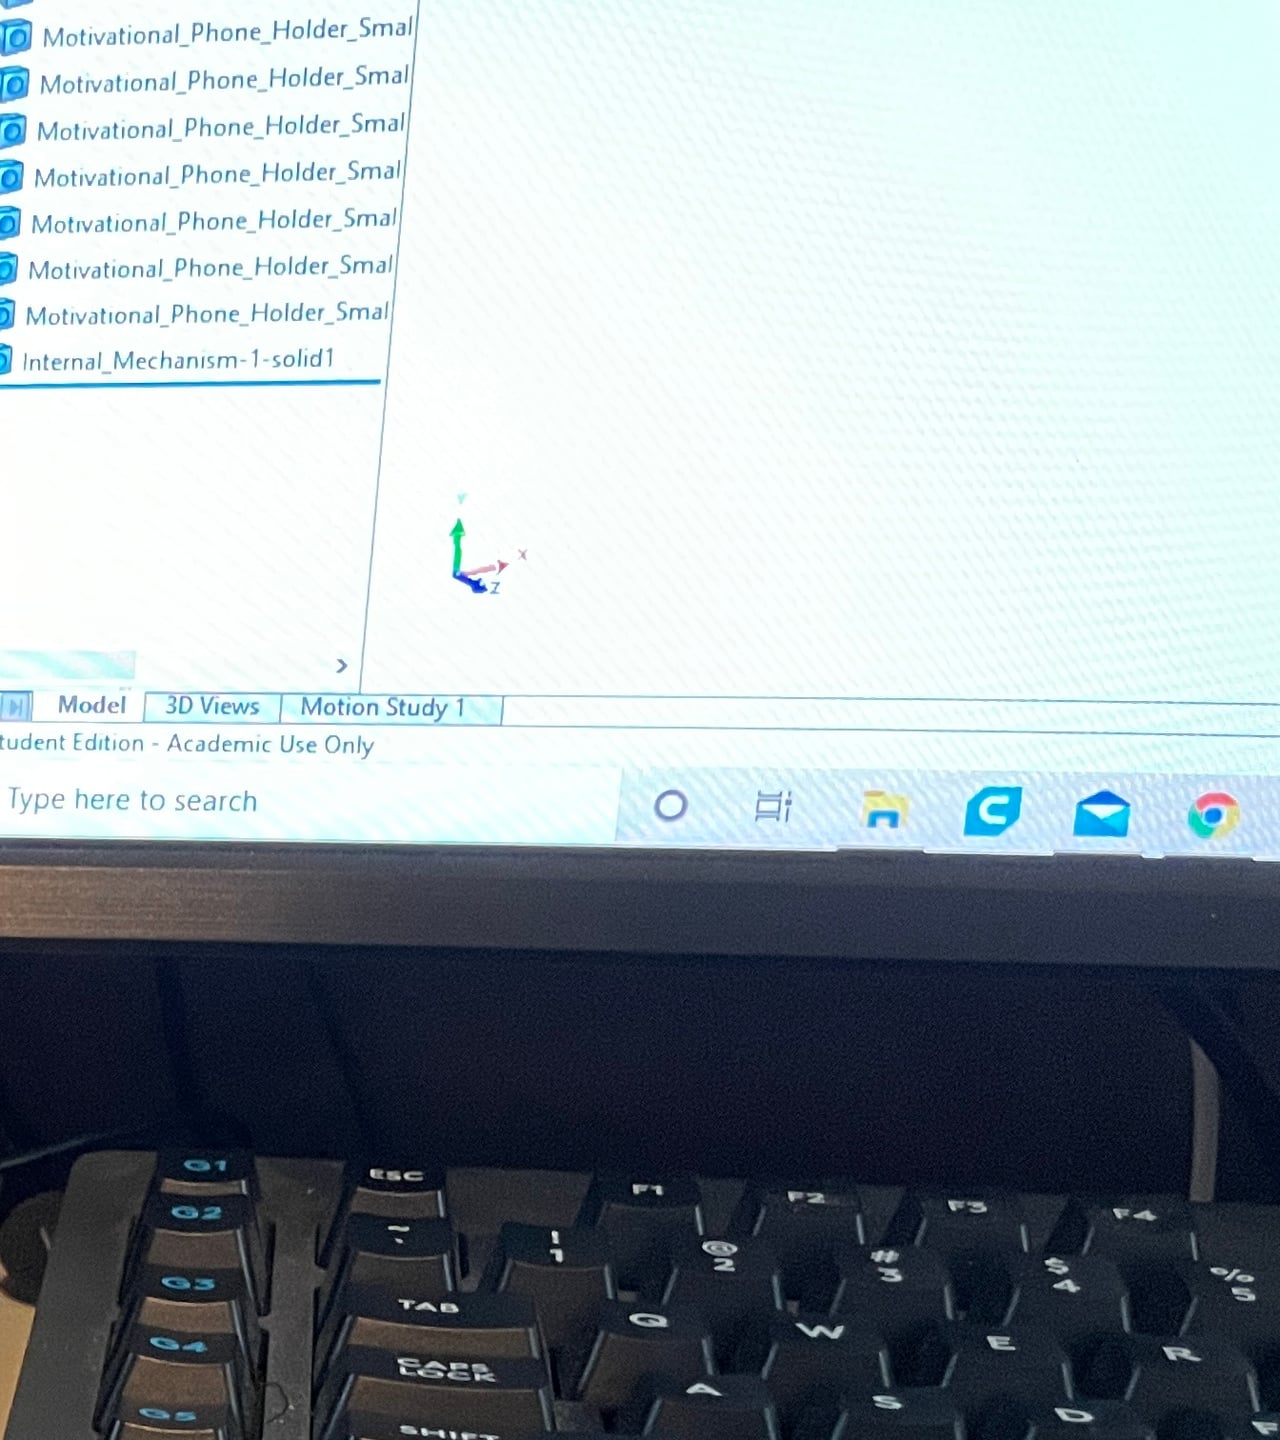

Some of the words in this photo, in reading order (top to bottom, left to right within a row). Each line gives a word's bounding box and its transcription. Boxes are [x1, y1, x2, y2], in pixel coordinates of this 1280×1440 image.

[57, 694, 127, 716] Model
[165, 696, 194, 716] 3D
[199, 696, 260, 717] Views
[301, 696, 378, 718] Motion
[385, 696, 447, 722] Study
[455, 697, 465, 717] 1
[73, 732, 144, 753] Edition
[167, 733, 271, 755] Academic
[280, 735, 317, 756] Use
[324, 735, 375, 760] Only
[7, 786, 65, 813] Type
[75, 788, 130, 811] here
[140, 790, 166, 813] to
[174, 789, 258, 814] search
[183, 1159, 228, 1172] G1
[369, 1168, 424, 1182] ESC
[632, 1184, 664, 1196] F1
[787, 1190, 825, 1204] F2
[170, 1205, 223, 1221] G2
[947, 1200, 988, 1213] F3
[1112, 1207, 1158, 1221] F4
[702, 1240, 738, 1257] @
[713, 1257, 736, 1272] 2
[877, 1266, 903, 1282] 3
[160, 1276, 216, 1291] G3
[1052, 1278, 1081, 1293] 4
[1231, 1287, 1256, 1302] 5
[398, 1298, 460, 1313] TAB
[628, 1312, 669, 1328] Q
[795, 1322, 845, 1340] W
[149, 1336, 208, 1353] G4
[986, 1335, 1017, 1351] E
[1161, 1345, 1202, 1361] R
[397, 1357, 491, 1373] CAPS
[398, 1366, 497, 1382] LOCK
[685, 1382, 722, 1396] A
[872, 1394, 903, 1409] S
[138, 1406, 197, 1422] G5
[1053, 1406, 1094, 1422] D
